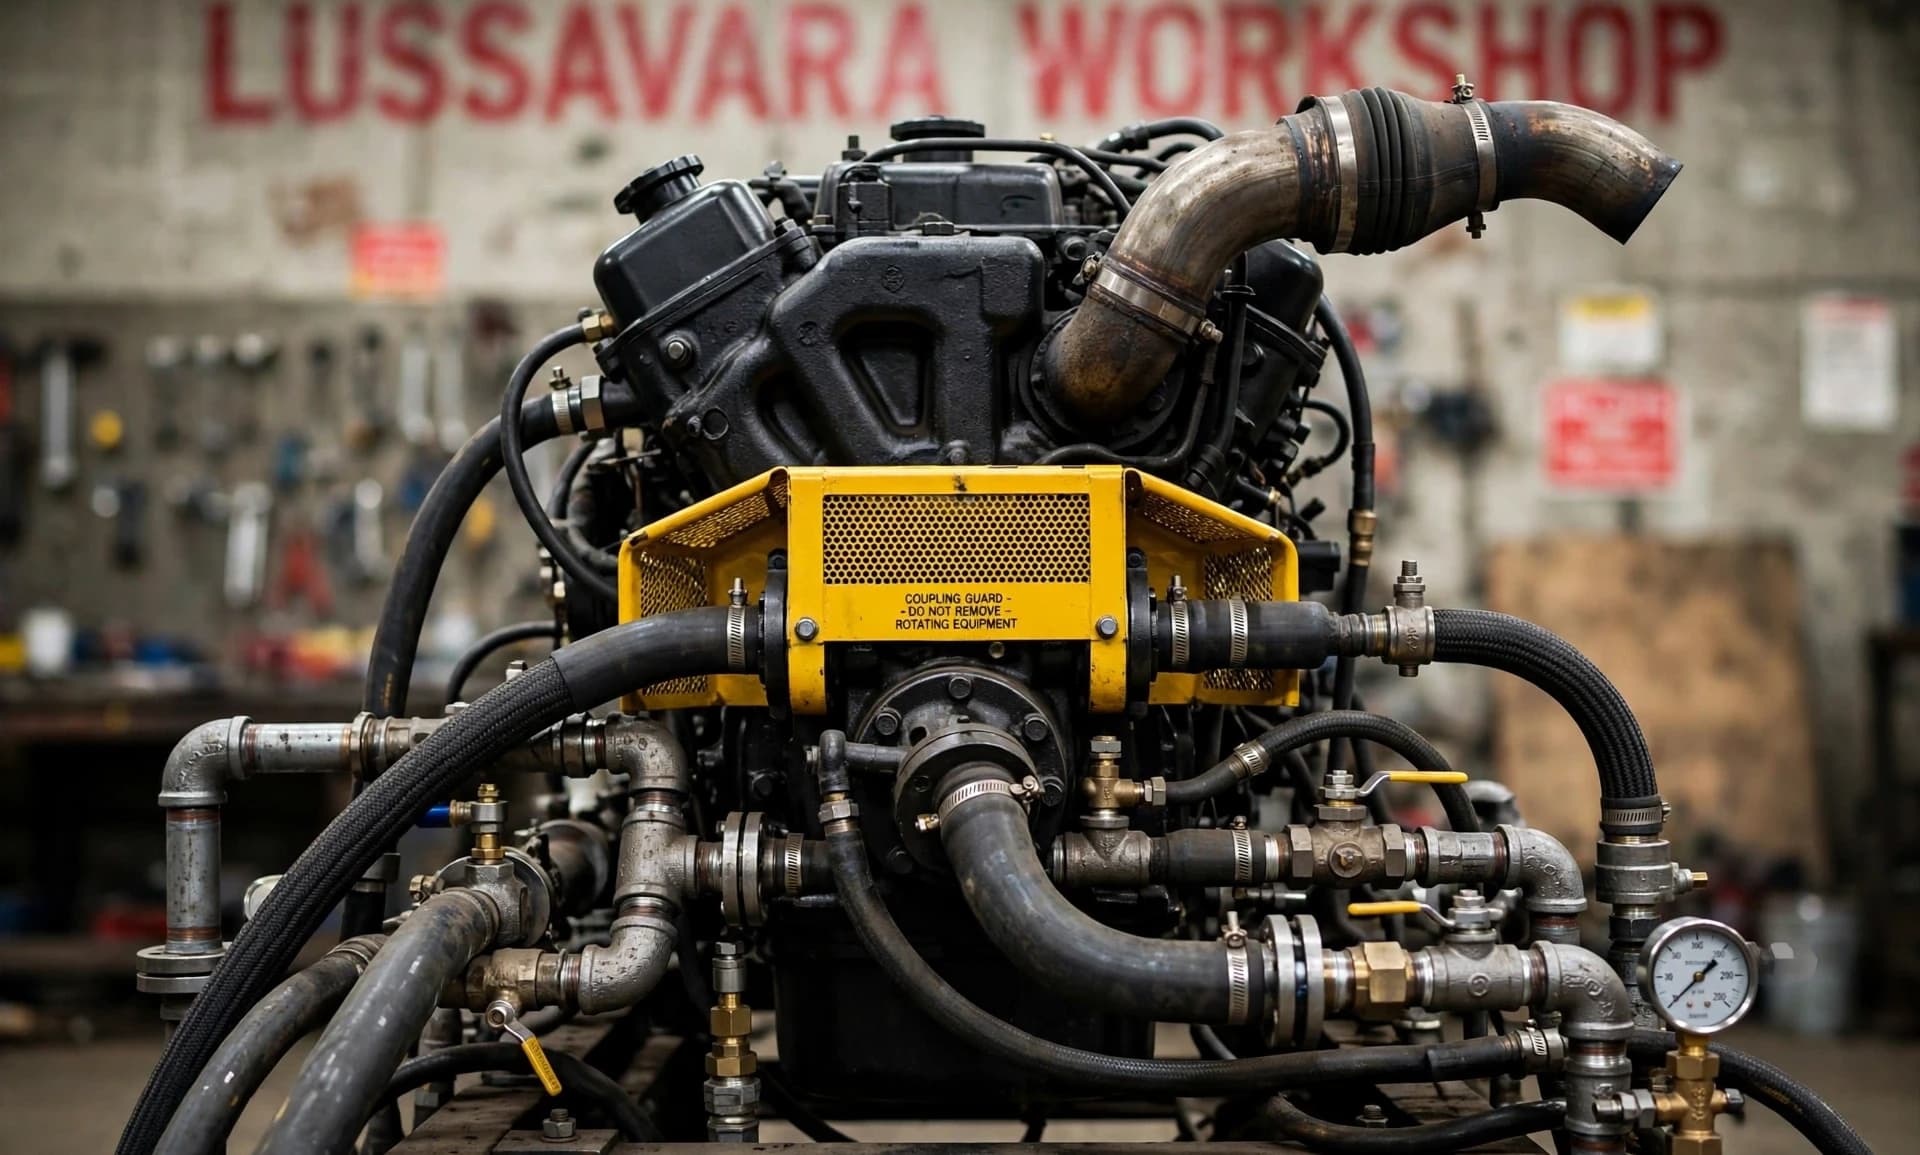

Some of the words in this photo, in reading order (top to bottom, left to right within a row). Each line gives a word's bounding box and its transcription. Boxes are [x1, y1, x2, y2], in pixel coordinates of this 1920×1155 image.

[206, 0, 947, 123] LUSSAVARA
[1017, 0, 1727, 122] WORKSHOP
[905, 593, 961, 604] COUPLING
[965, 593, 1003, 604] GUARD
[908, 606, 925, 617] DO
[928, 606, 951, 617] NOT
[955, 605, 1001, 616] REMOVE
[896, 618, 950, 630] ROTATING
[953, 617, 1017, 630] EQUIPMENT
